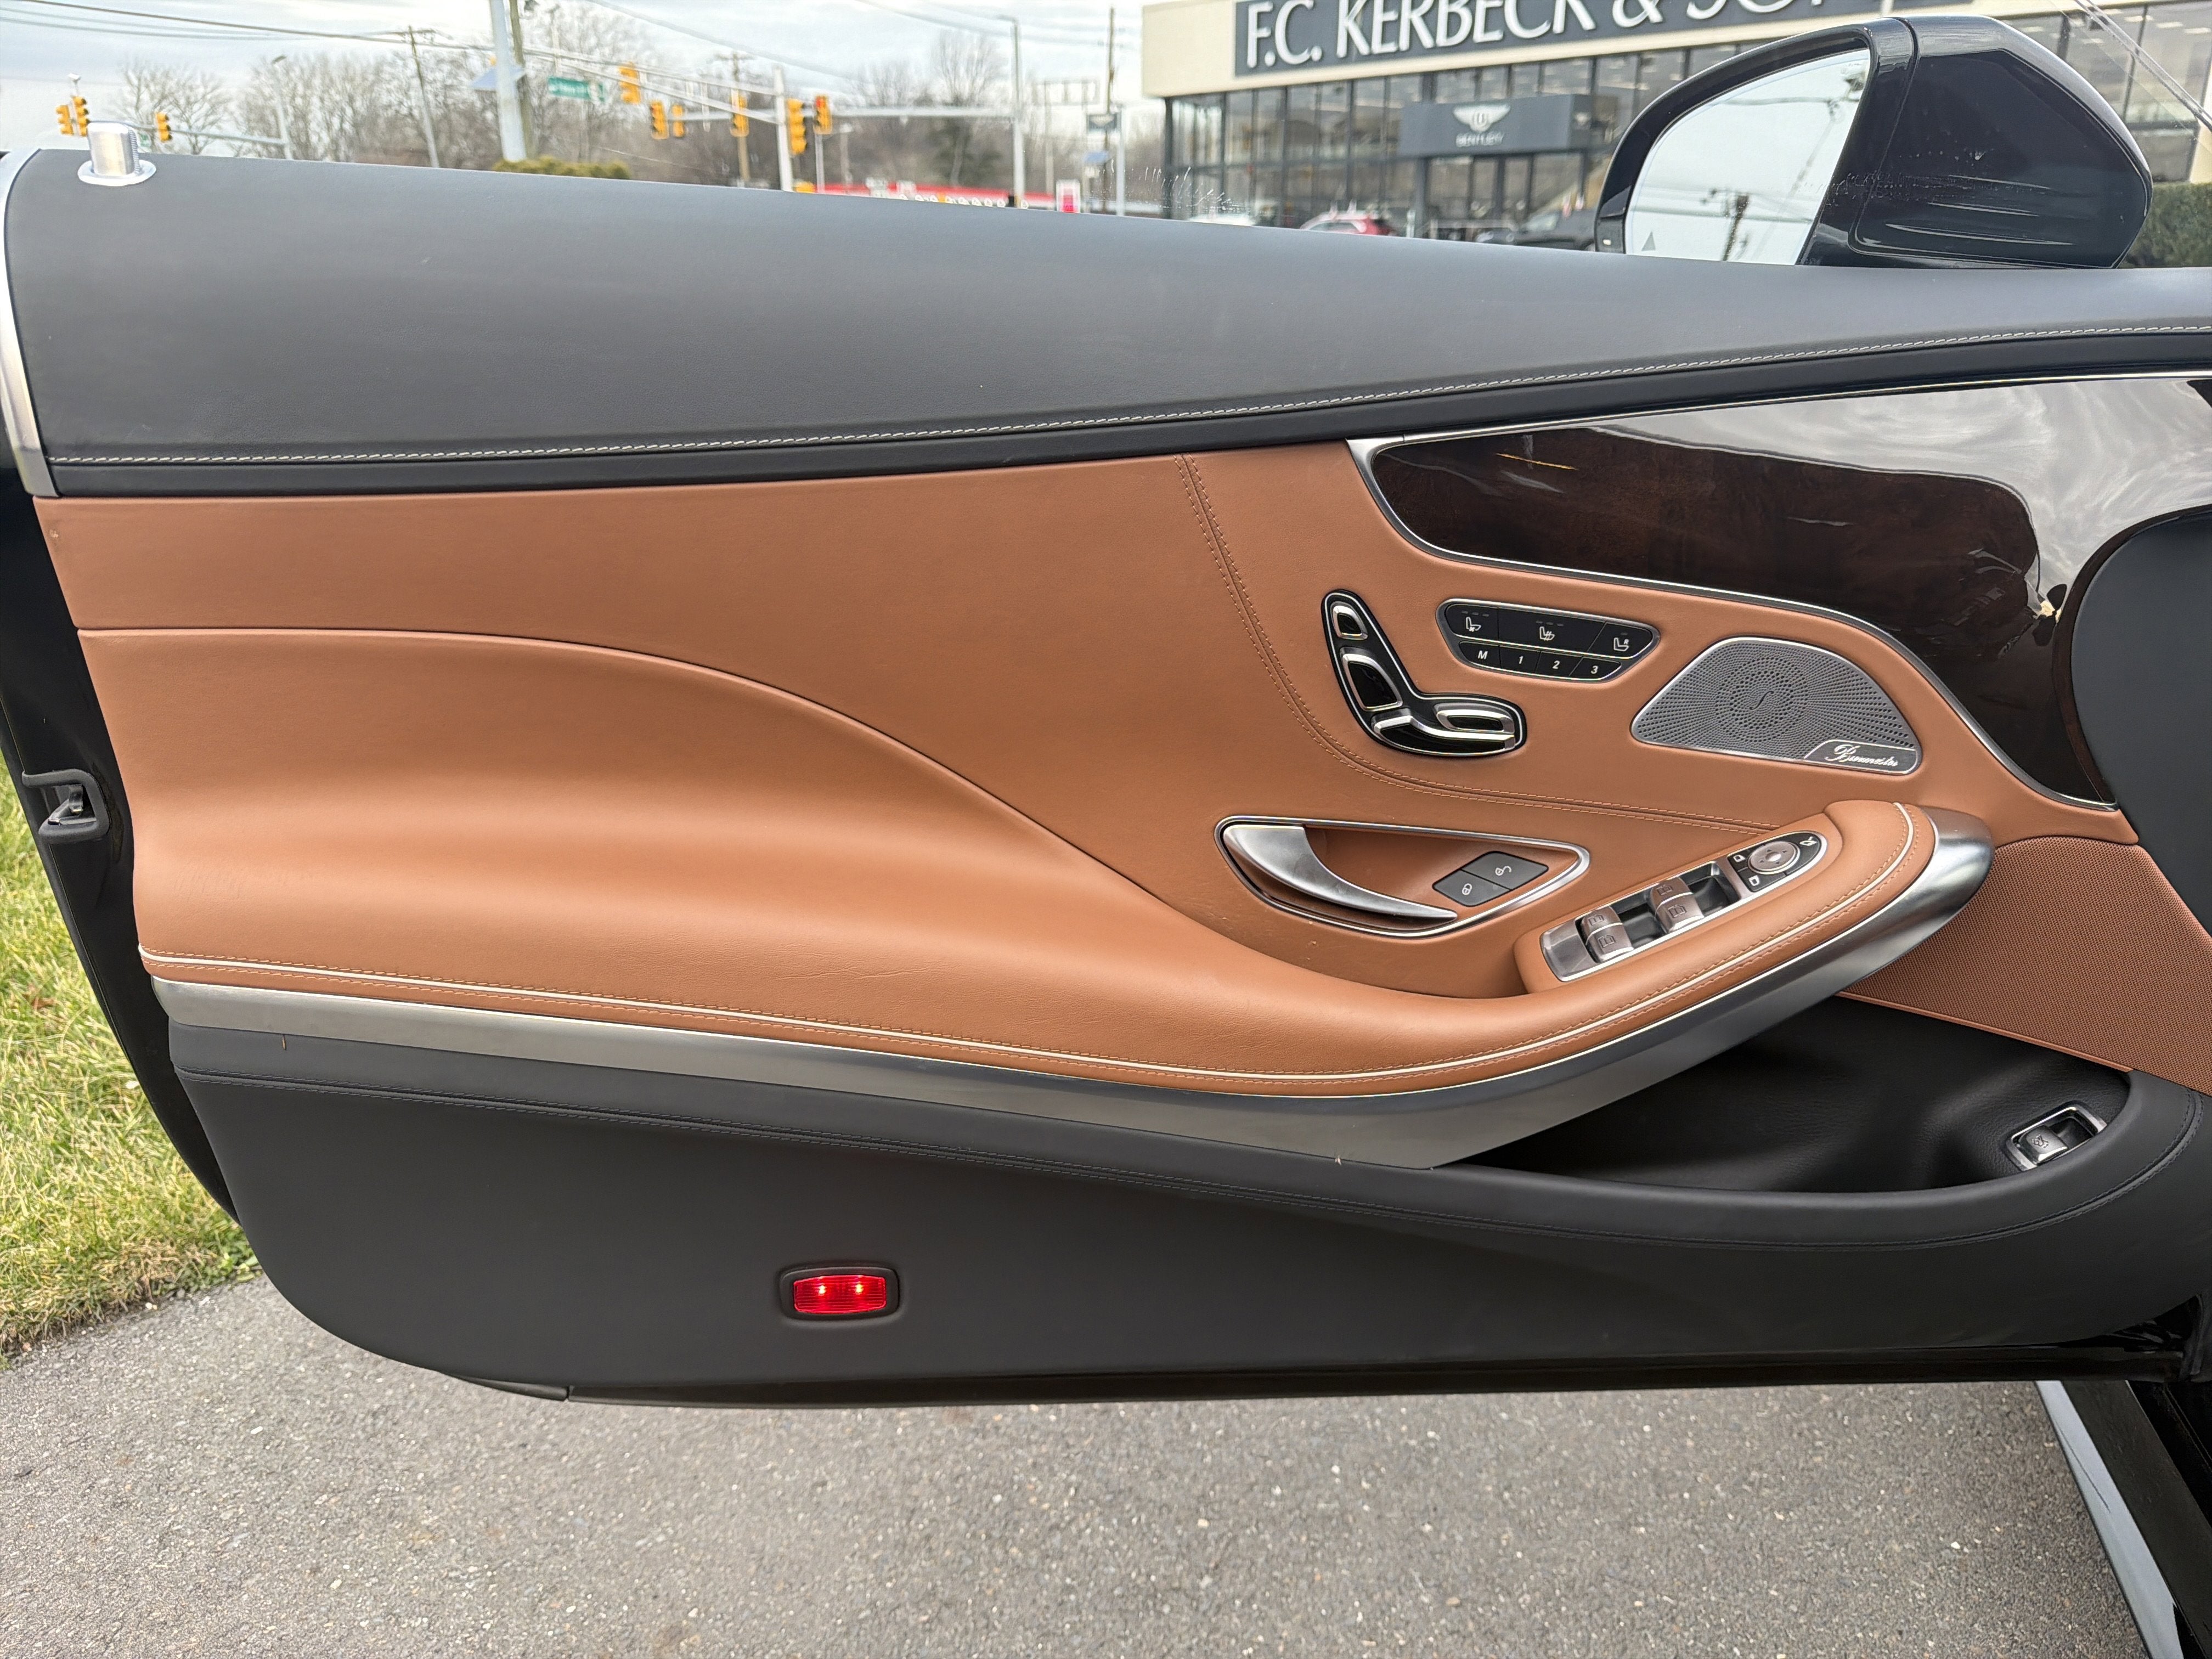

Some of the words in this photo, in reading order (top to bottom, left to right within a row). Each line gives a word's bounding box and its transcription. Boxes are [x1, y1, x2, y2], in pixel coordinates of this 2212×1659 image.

[1246, 0, 1321, 68] F.C.
[1336, 0, 1598, 58] KERBECK
[1477, 650, 1488, 660] M
[1518, 656, 1523, 664] 1
[1552, 660, 1560, 669] 2
[1590, 665, 1598, 674] 3
